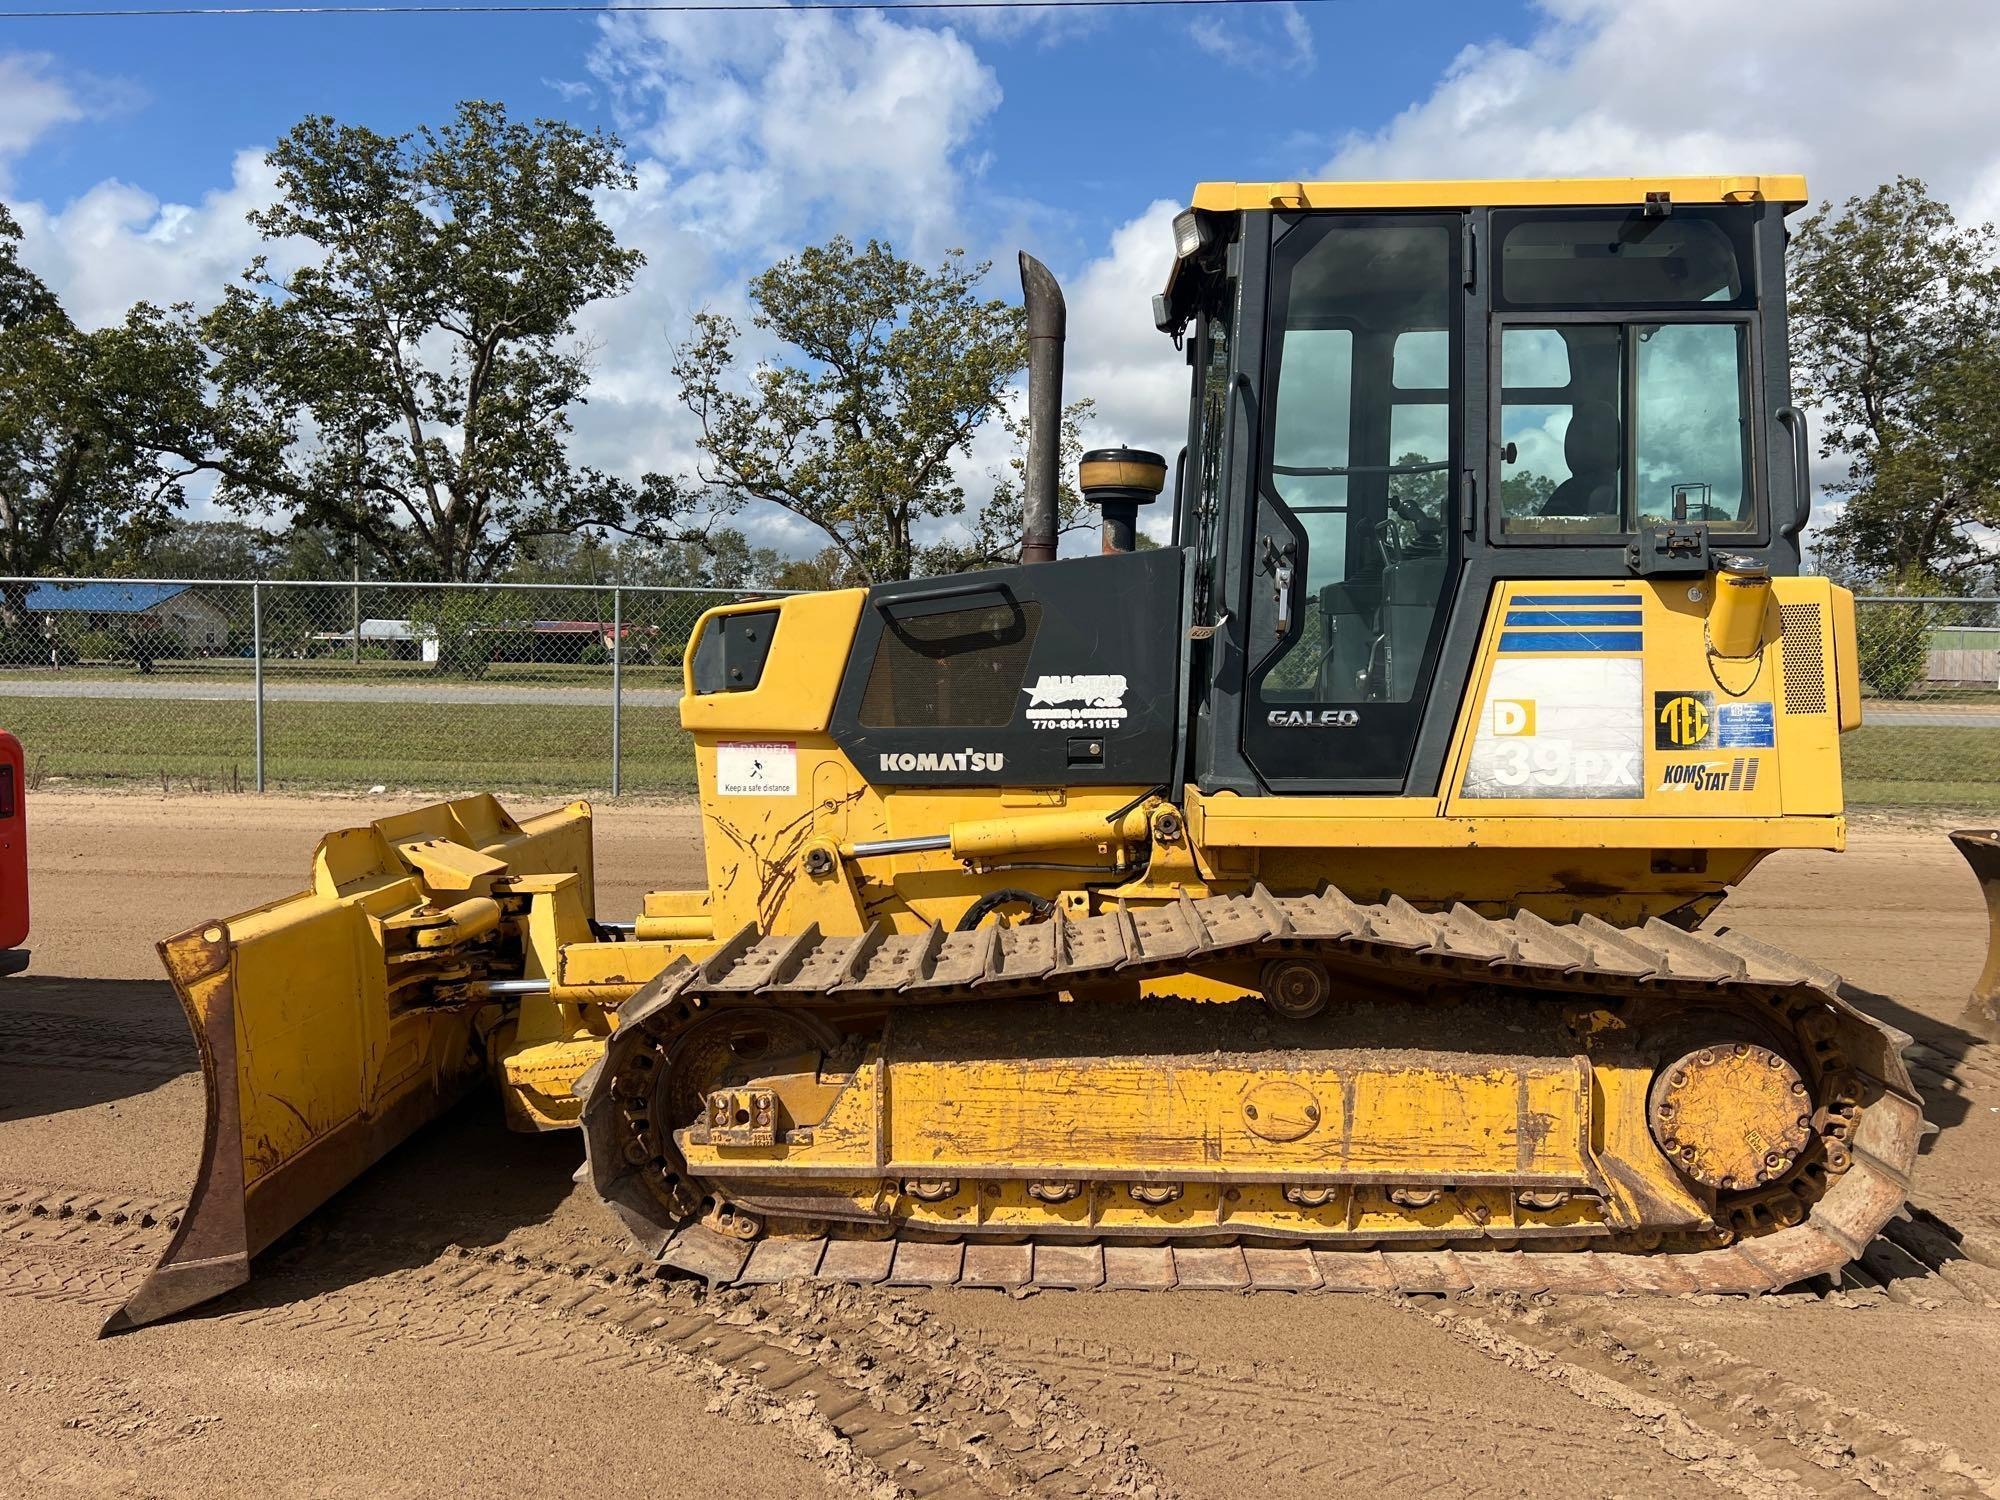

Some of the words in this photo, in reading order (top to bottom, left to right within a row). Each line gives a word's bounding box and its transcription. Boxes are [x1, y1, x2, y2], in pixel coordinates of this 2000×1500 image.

[1267, 710, 1359, 727] GALEO
[1494, 701, 1527, 735] D
[740, 744, 790, 754] DANGER
[880, 748, 1004, 772] KOMATSU
[1494, 739, 1639, 786] 39PX
[725, 783, 742, 793] Keep
[748, 783, 762, 792] safe
[763, 783, 790, 792] distance
